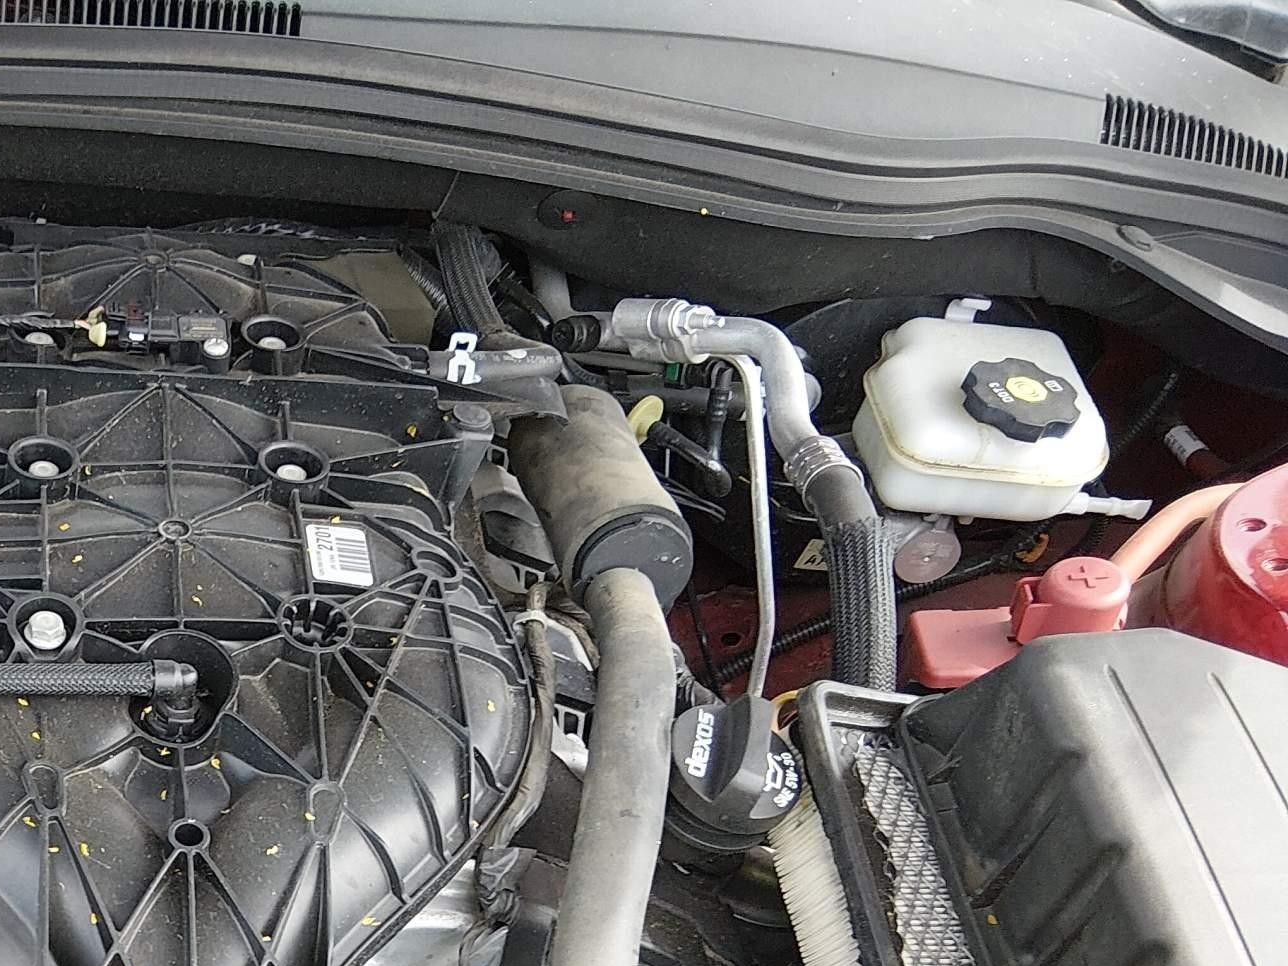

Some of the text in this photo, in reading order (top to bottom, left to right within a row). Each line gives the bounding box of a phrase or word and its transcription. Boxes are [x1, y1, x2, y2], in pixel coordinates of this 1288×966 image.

[988, 381, 1015, 403] DOT3
[314, 526, 333, 552] 2701
[684, 708, 715, 778] dexos
